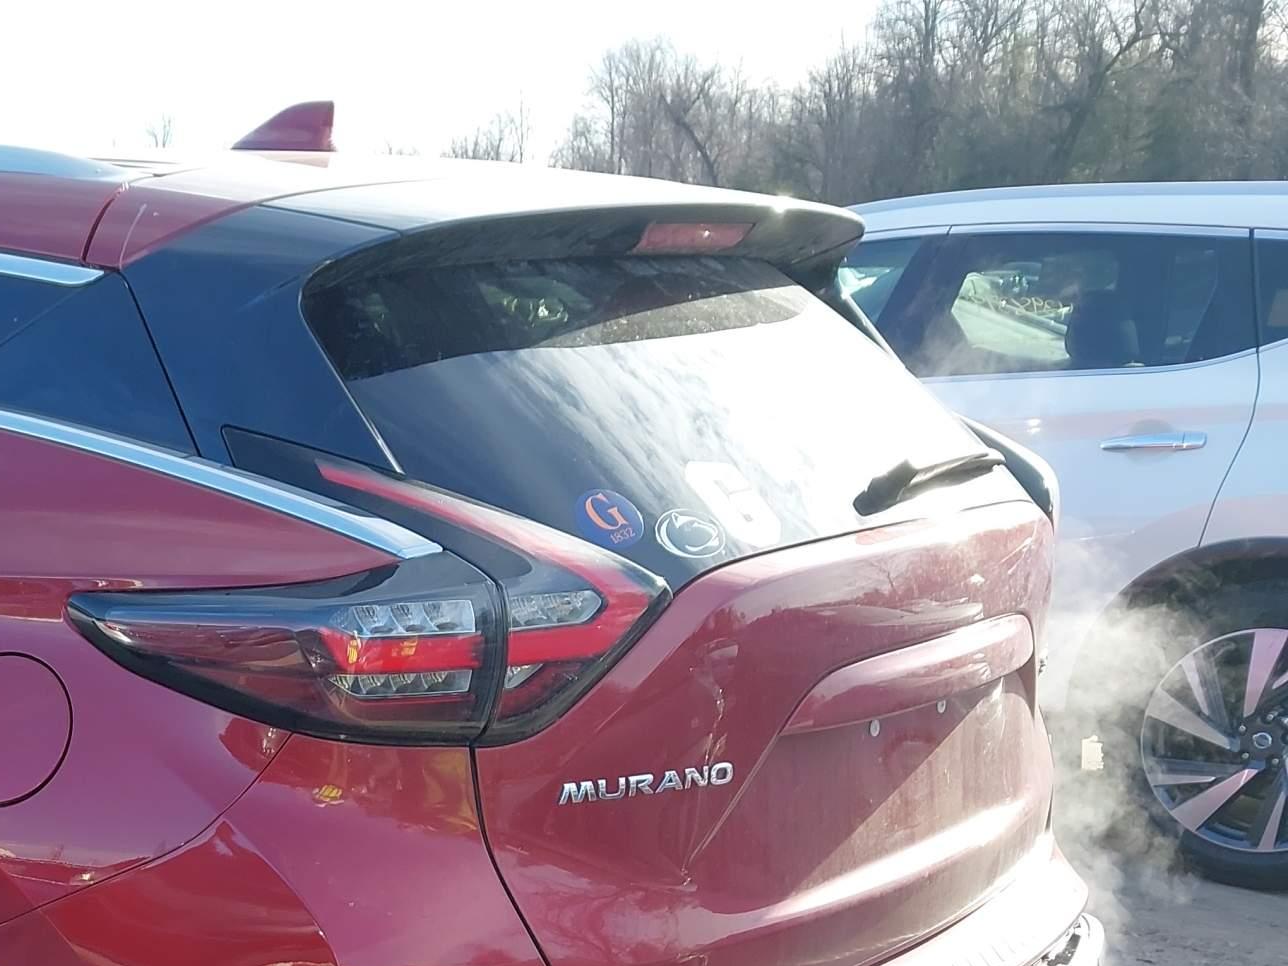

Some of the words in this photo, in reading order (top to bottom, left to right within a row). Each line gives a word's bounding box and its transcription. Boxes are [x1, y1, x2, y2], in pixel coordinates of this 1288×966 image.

[584, 492, 629, 531] G
[609, 526, 637, 545] 1832
[558, 761, 734, 806] MURANO
